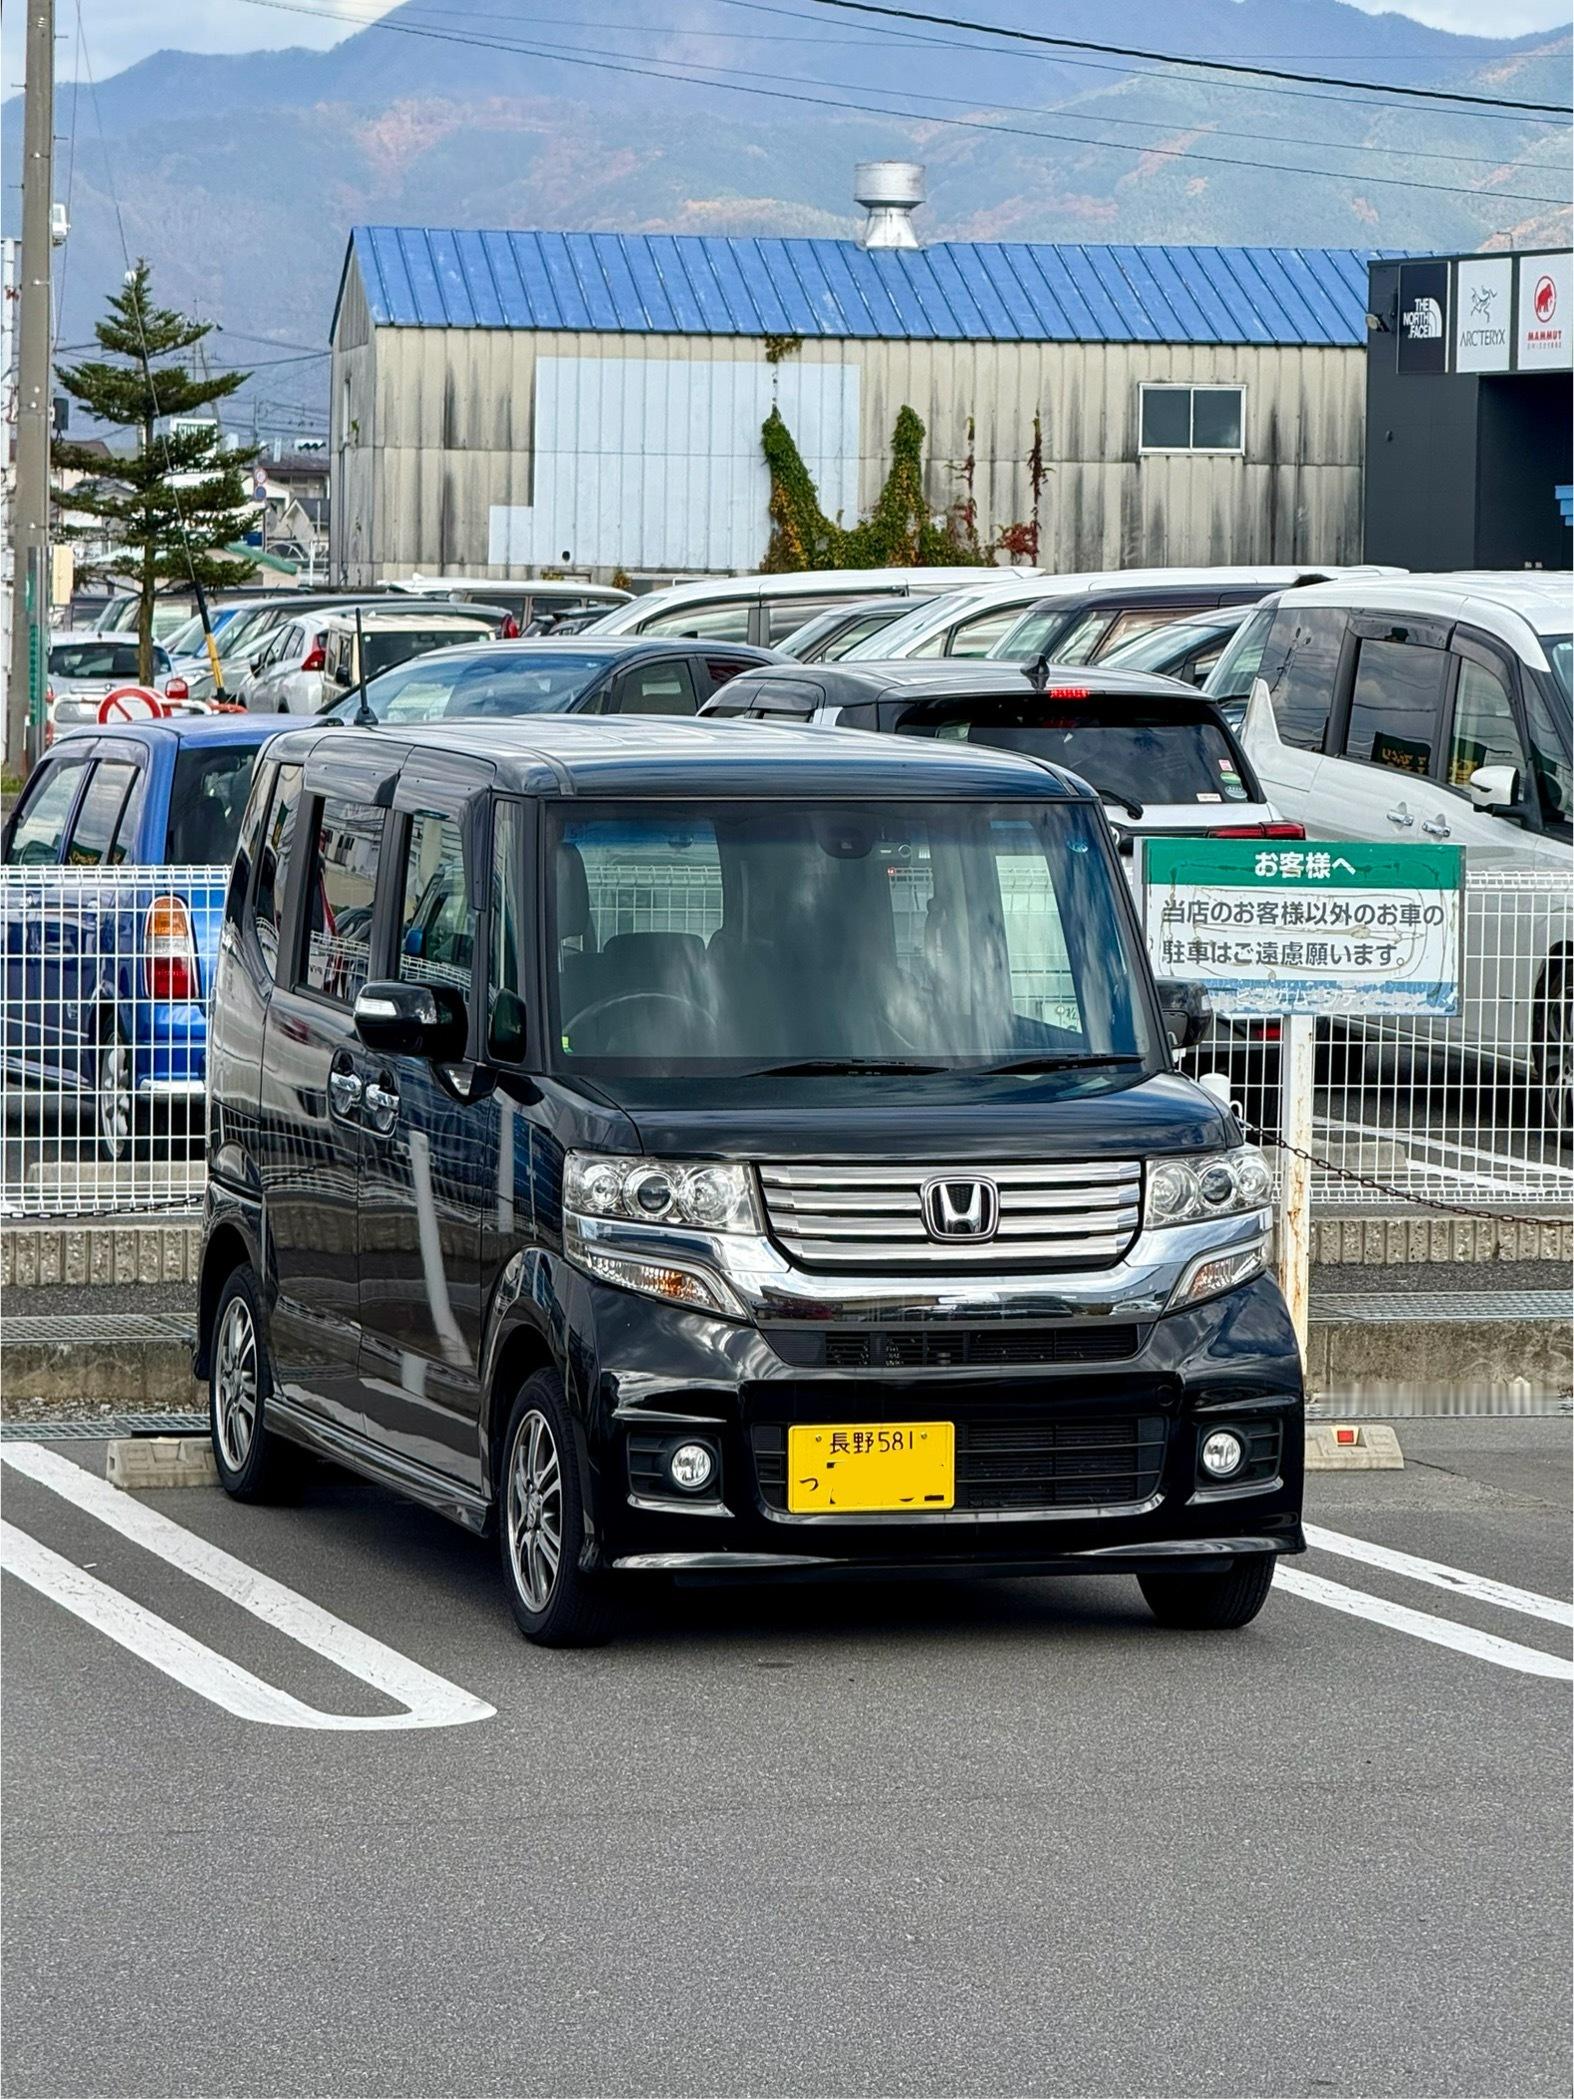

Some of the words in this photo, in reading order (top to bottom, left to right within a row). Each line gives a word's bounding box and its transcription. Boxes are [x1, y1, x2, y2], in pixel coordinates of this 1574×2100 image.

[1415, 298, 1430, 311] THE
[1403, 312, 1429, 326] NORTH
[1408, 325, 1429, 338] FACE
[1527, 330, 1562, 341] MAMMUT
[1255, 851, 1356, 878] お客様へ
[1162, 900, 1444, 926] 当店のお客様以外のお車の
[1162, 940, 1404, 967] 駐車はご遠慮願います。
[799, 1477, 819, 1492] つ
